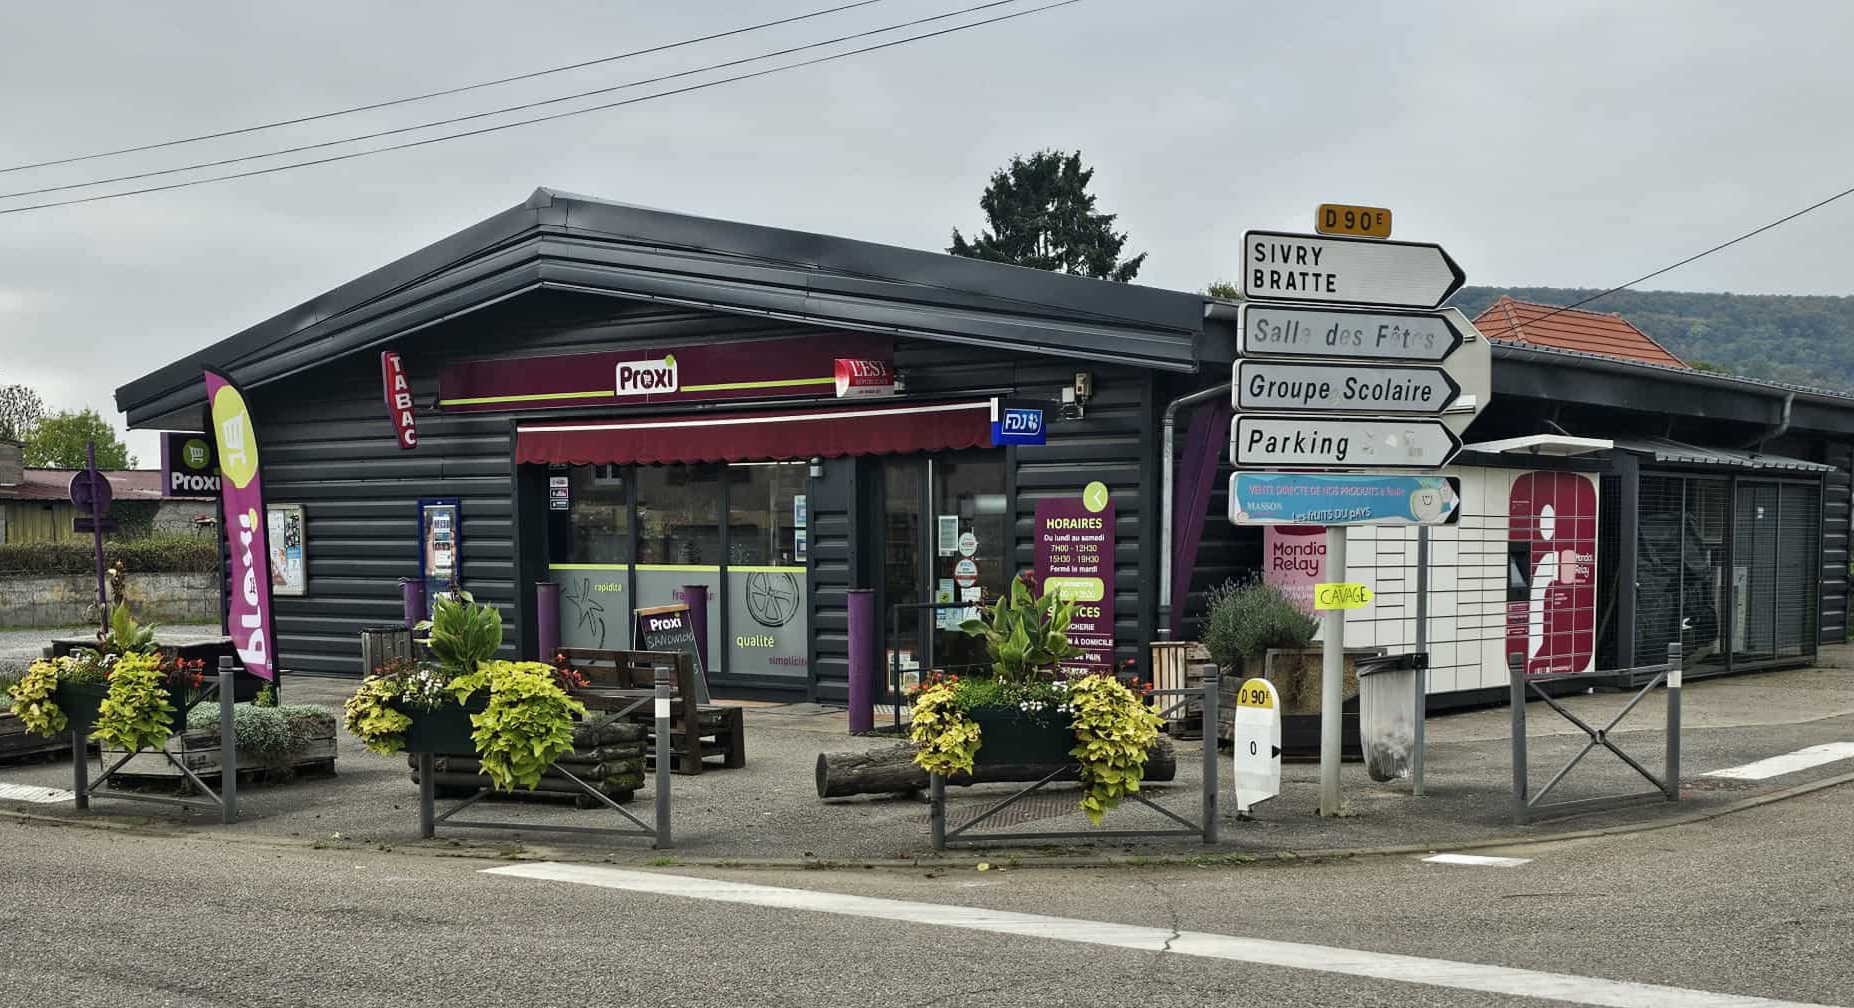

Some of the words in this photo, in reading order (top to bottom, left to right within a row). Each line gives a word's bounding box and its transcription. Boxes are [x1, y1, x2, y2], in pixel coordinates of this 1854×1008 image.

[1325, 209, 1337, 228] D
[1254, 242, 1323, 266] SIVRY
[1253, 269, 1337, 293] BRATTE
[1254, 318, 1311, 344] Salle
[1325, 322, 1363, 347] des
[1375, 324, 1436, 350] Fêtes
[620, 354, 674, 391] Proxi
[1249, 374, 1331, 405] Groupe
[1343, 376, 1432, 402] Scolaire
[390, 356, 416, 445] TABAC
[1005, 413, 1026, 431] FDJ
[1247, 429, 1350, 461] Parking
[171, 469, 221, 490] Proxi
[1046, 518, 1103, 529] HORAIRES
[1044, 534, 1053, 542] Du
[1054, 534, 1071, 542] lundi
[1081, 534, 1105, 542] samedi
[1051, 544, 1069, 552] 7H00
[1075, 544, 1098, 552] 12H30
[1273, 541, 1327, 556] Mondia
[1050, 565, 1071, 573] Fermé
[1079, 565, 1098, 573] mardi
[1273, 557, 1319, 577] Relay
[1320, 586, 1369, 605] CAVAGE
[1047, 606, 1101, 618] SICES
[650, 612, 682, 632] Proxi
[736, 634, 775, 649] qualité
[1080, 638, 1114, 647] DOMICILE
[1241, 688, 1248, 703] D
[1250, 740, 1257, 756] 0
